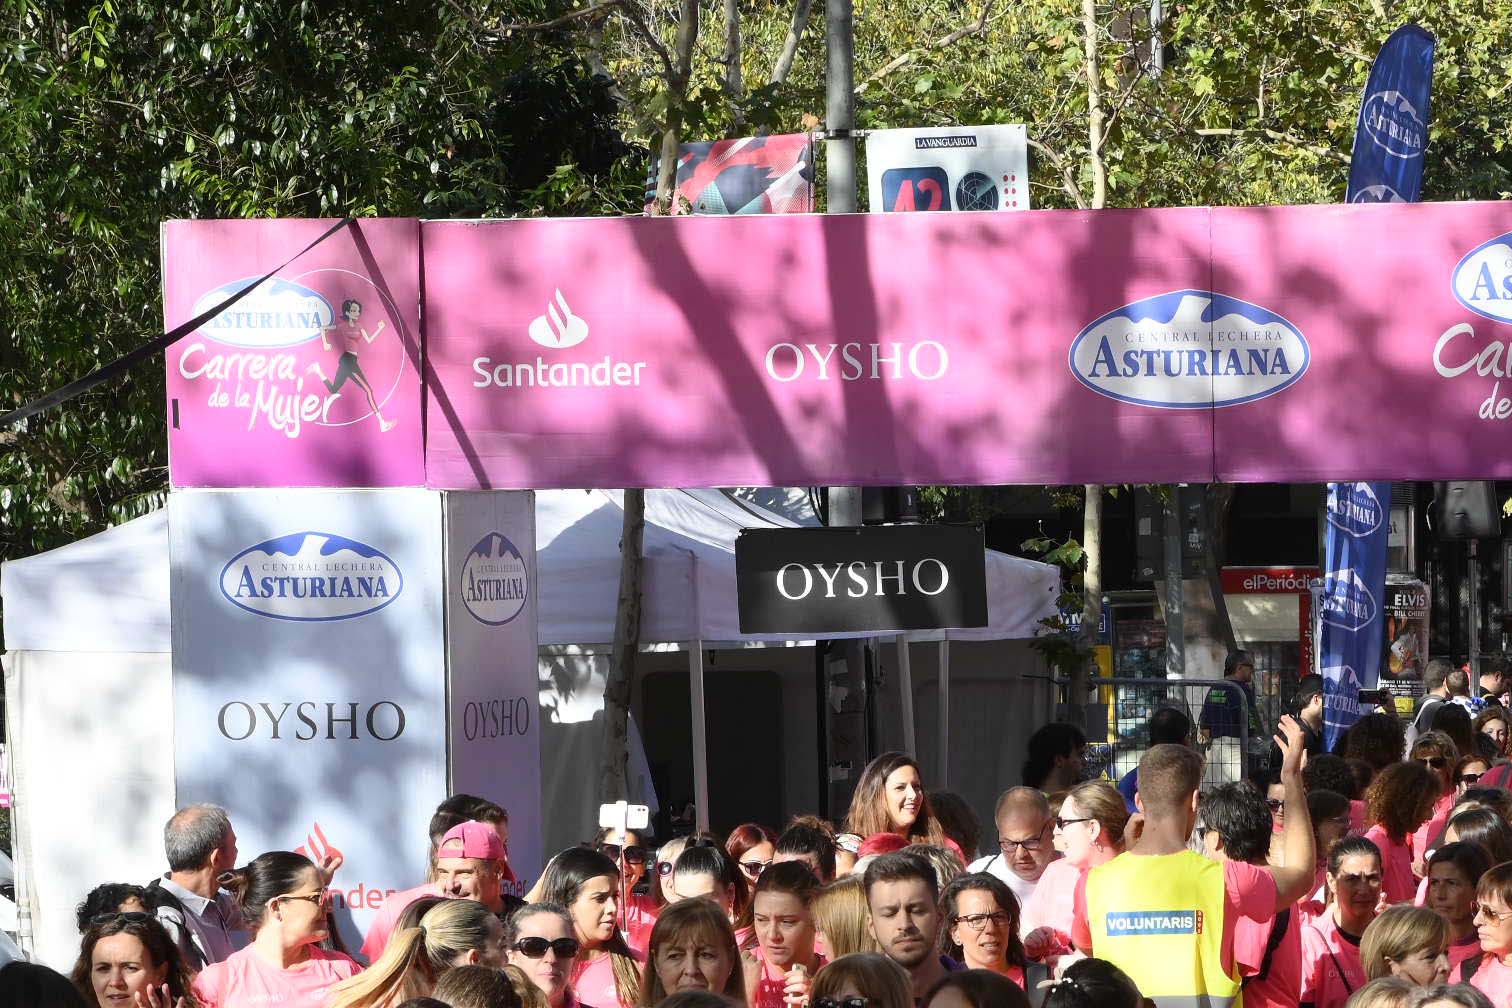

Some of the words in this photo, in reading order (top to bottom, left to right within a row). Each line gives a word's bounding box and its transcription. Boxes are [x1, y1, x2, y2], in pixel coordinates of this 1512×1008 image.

[1124, 331, 1200, 344] CENTRAL
[1208, 330, 1284, 343] LECHERA
[179, 343, 297, 380] Carrera
[472, 356, 646, 389] Santander
[764, 340, 949, 382] OYSHO
[1087, 334, 1291, 379] ASTURIANA
[208, 384, 230, 408] de
[234, 386, 250, 408] la
[248, 377, 342, 439] Mujer
[234, 564, 390, 599] ASTURIANA
[261, 562, 320, 573] CENTRAL
[325, 561, 384, 573] LECHERA
[467, 566, 525, 603] ASTURIANA
[776, 557, 950, 600] OYSHO
[1394, 593, 1425, 606] ELVIS
[217, 700, 406, 741] OYSHO
[463, 696, 530, 741] OYSHO
[1107, 915, 1194, 931] VOLUNTARIS
